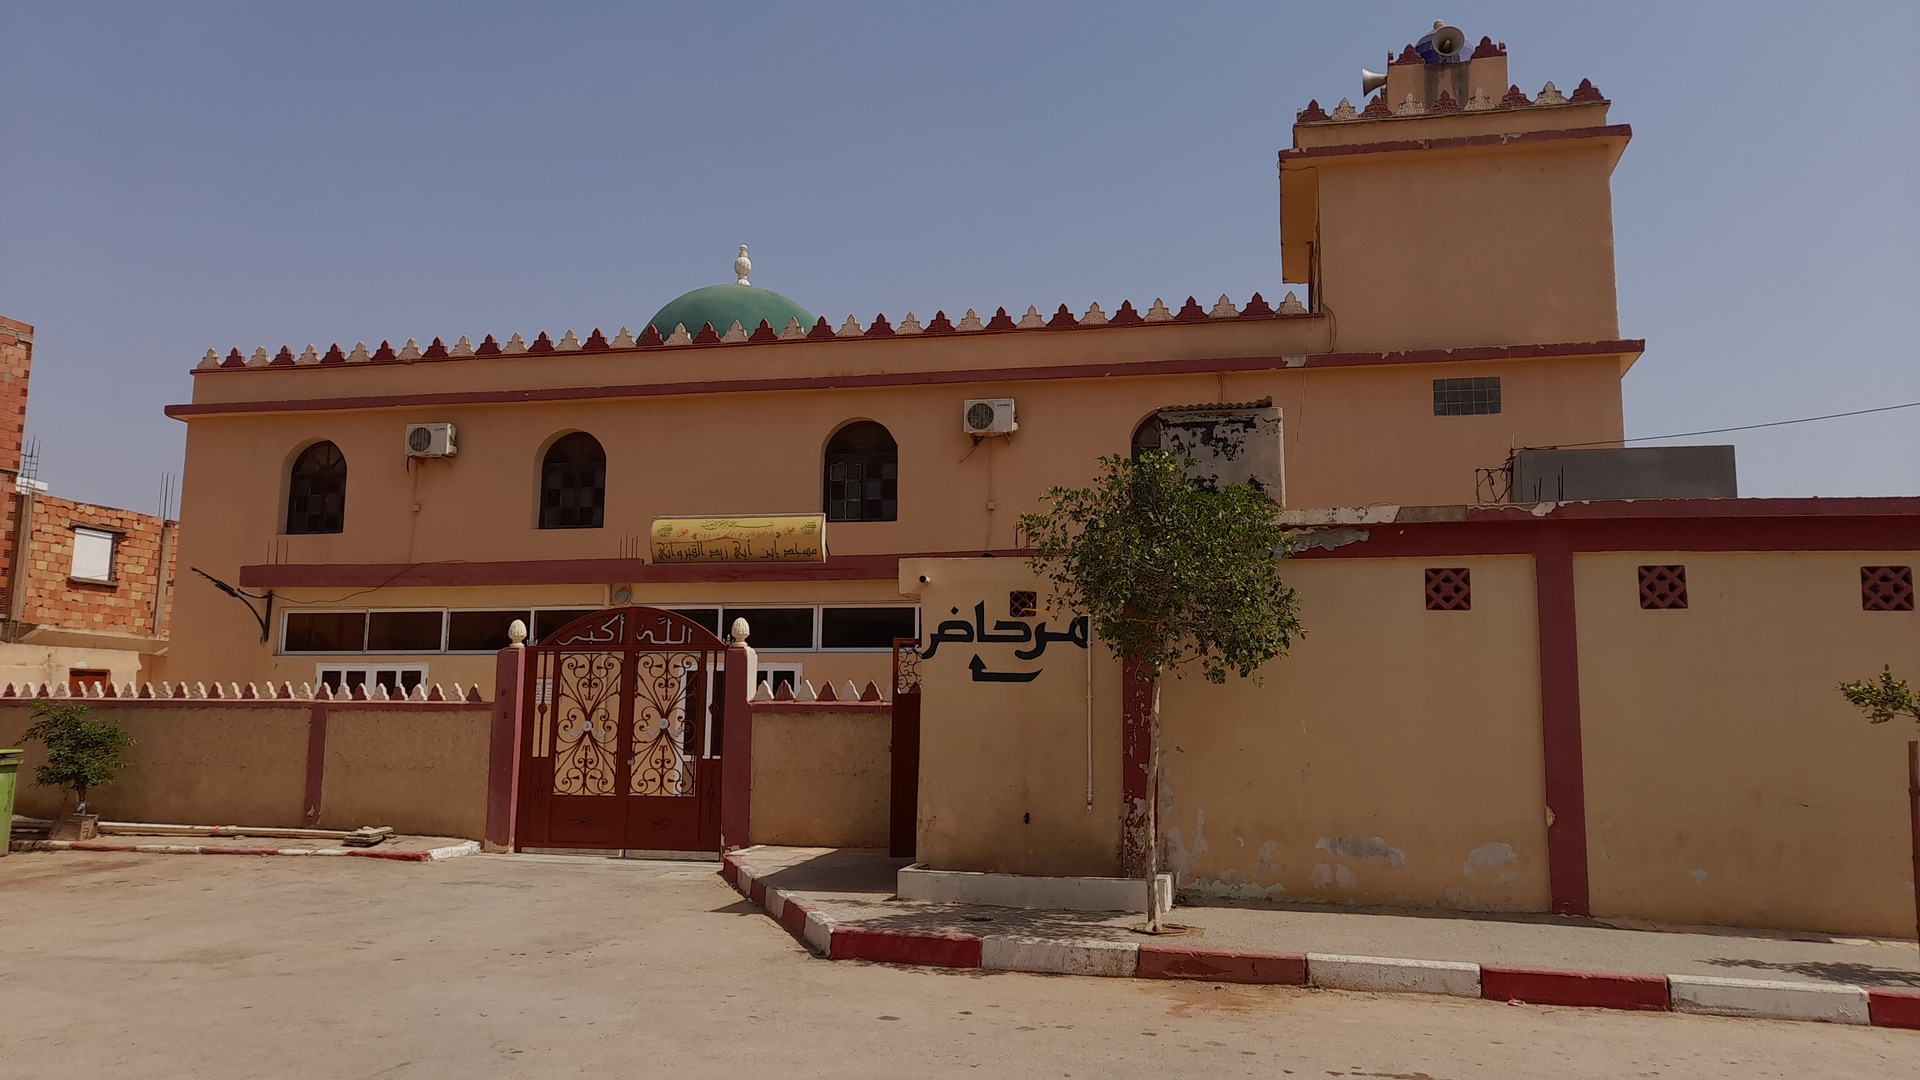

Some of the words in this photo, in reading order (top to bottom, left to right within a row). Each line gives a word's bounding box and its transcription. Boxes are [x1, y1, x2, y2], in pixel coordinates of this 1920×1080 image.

[709, 545, 729, 560] زيد
[783, 542, 818, 558] مسجد
[921, 600, 1089, 660] مرحاض
